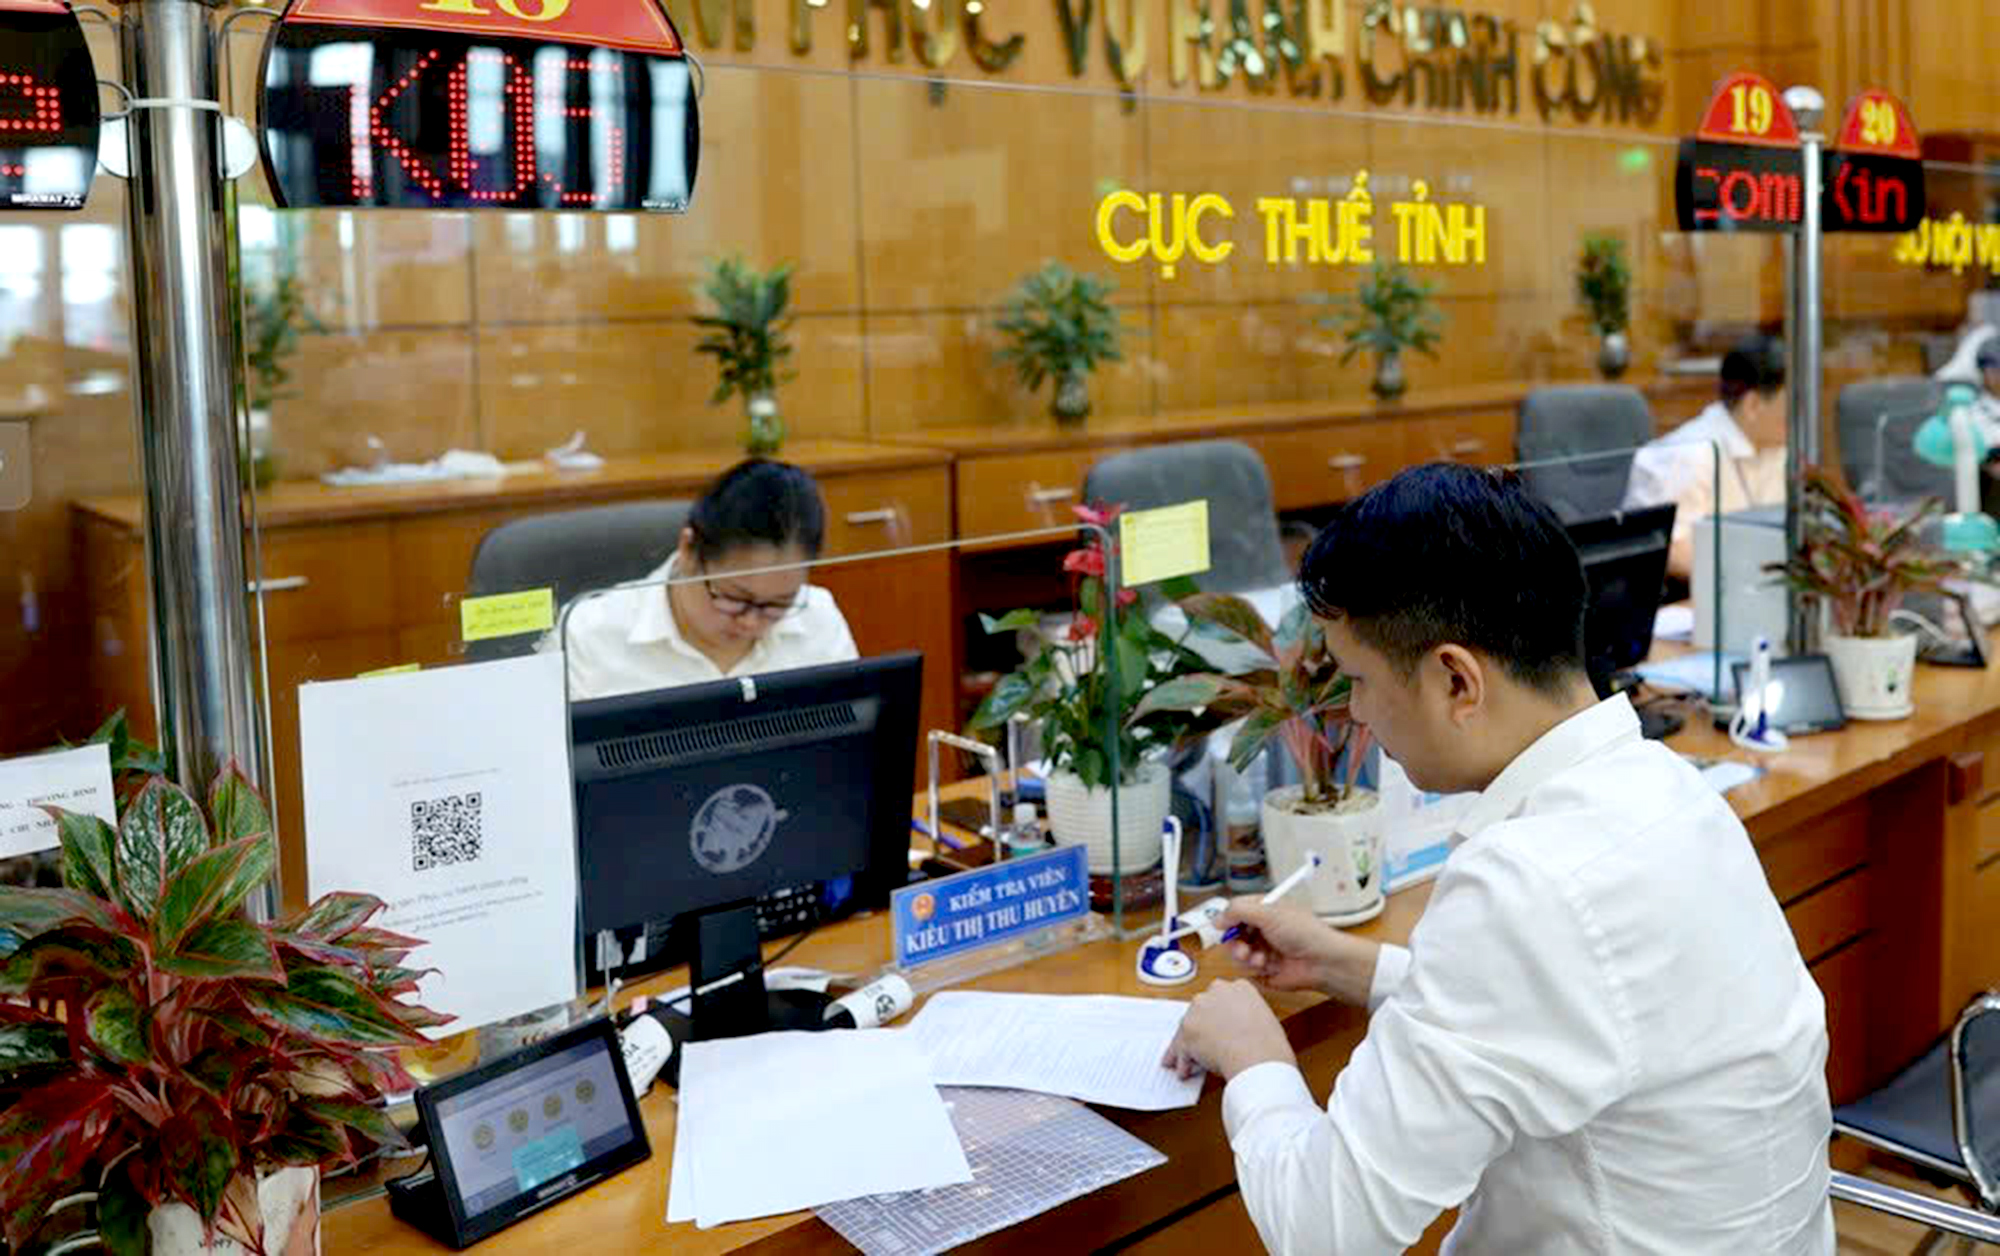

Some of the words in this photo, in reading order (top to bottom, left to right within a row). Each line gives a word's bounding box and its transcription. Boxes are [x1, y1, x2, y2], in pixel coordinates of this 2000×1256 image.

[1731, 84, 1773, 135] 19
[1096, 190, 1234, 279] CỤC
[1257, 169, 1374, 264] THUẾ
[1391, 179, 1486, 264] TỈNH
[950, 883, 992, 912] KIỂM
[994, 878, 1026, 900] TRA
[1027, 866, 1067, 890] VIÊN
[952, 916, 984, 940] THỊ
[986, 905, 1021, 931] THU
